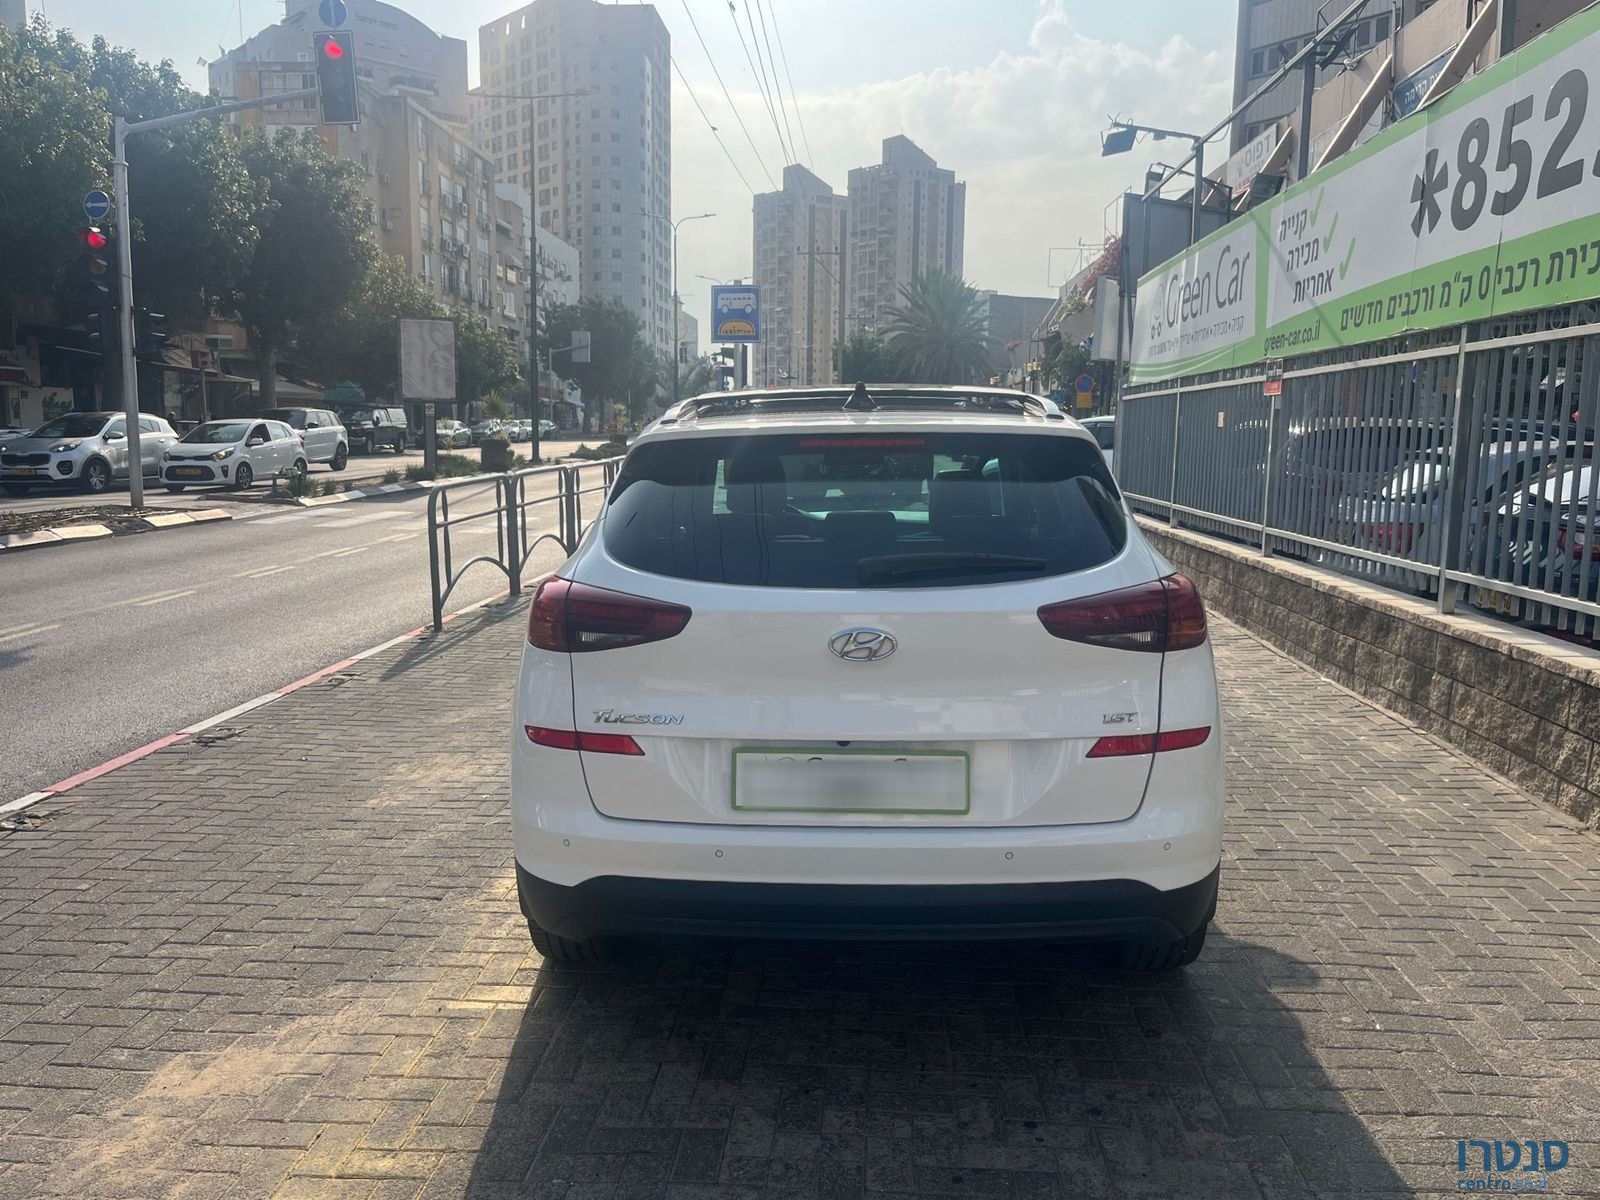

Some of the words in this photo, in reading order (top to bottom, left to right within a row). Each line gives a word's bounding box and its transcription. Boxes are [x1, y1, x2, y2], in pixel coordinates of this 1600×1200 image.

[1245, 134, 1271, 168] דפוס
[1410, 68, 1600, 239] 852
[1279, 208, 1308, 242] קנייה
[1287, 237, 1320, 272] מכירה
[1166, 273, 1211, 328] Green
[1215, 244, 1250, 309] Car
[1293, 267, 1335, 304] אחריות
[1478, 265, 1491, 301] 0
[1497, 257, 1541, 296] רכבי
[1340, 299, 1384, 331] חדשים
[1386, 284, 1436, 322] ורכבים
[1263, 318, 1321, 357] green-car.co.il
[593, 709, 684, 726] TUCSON
